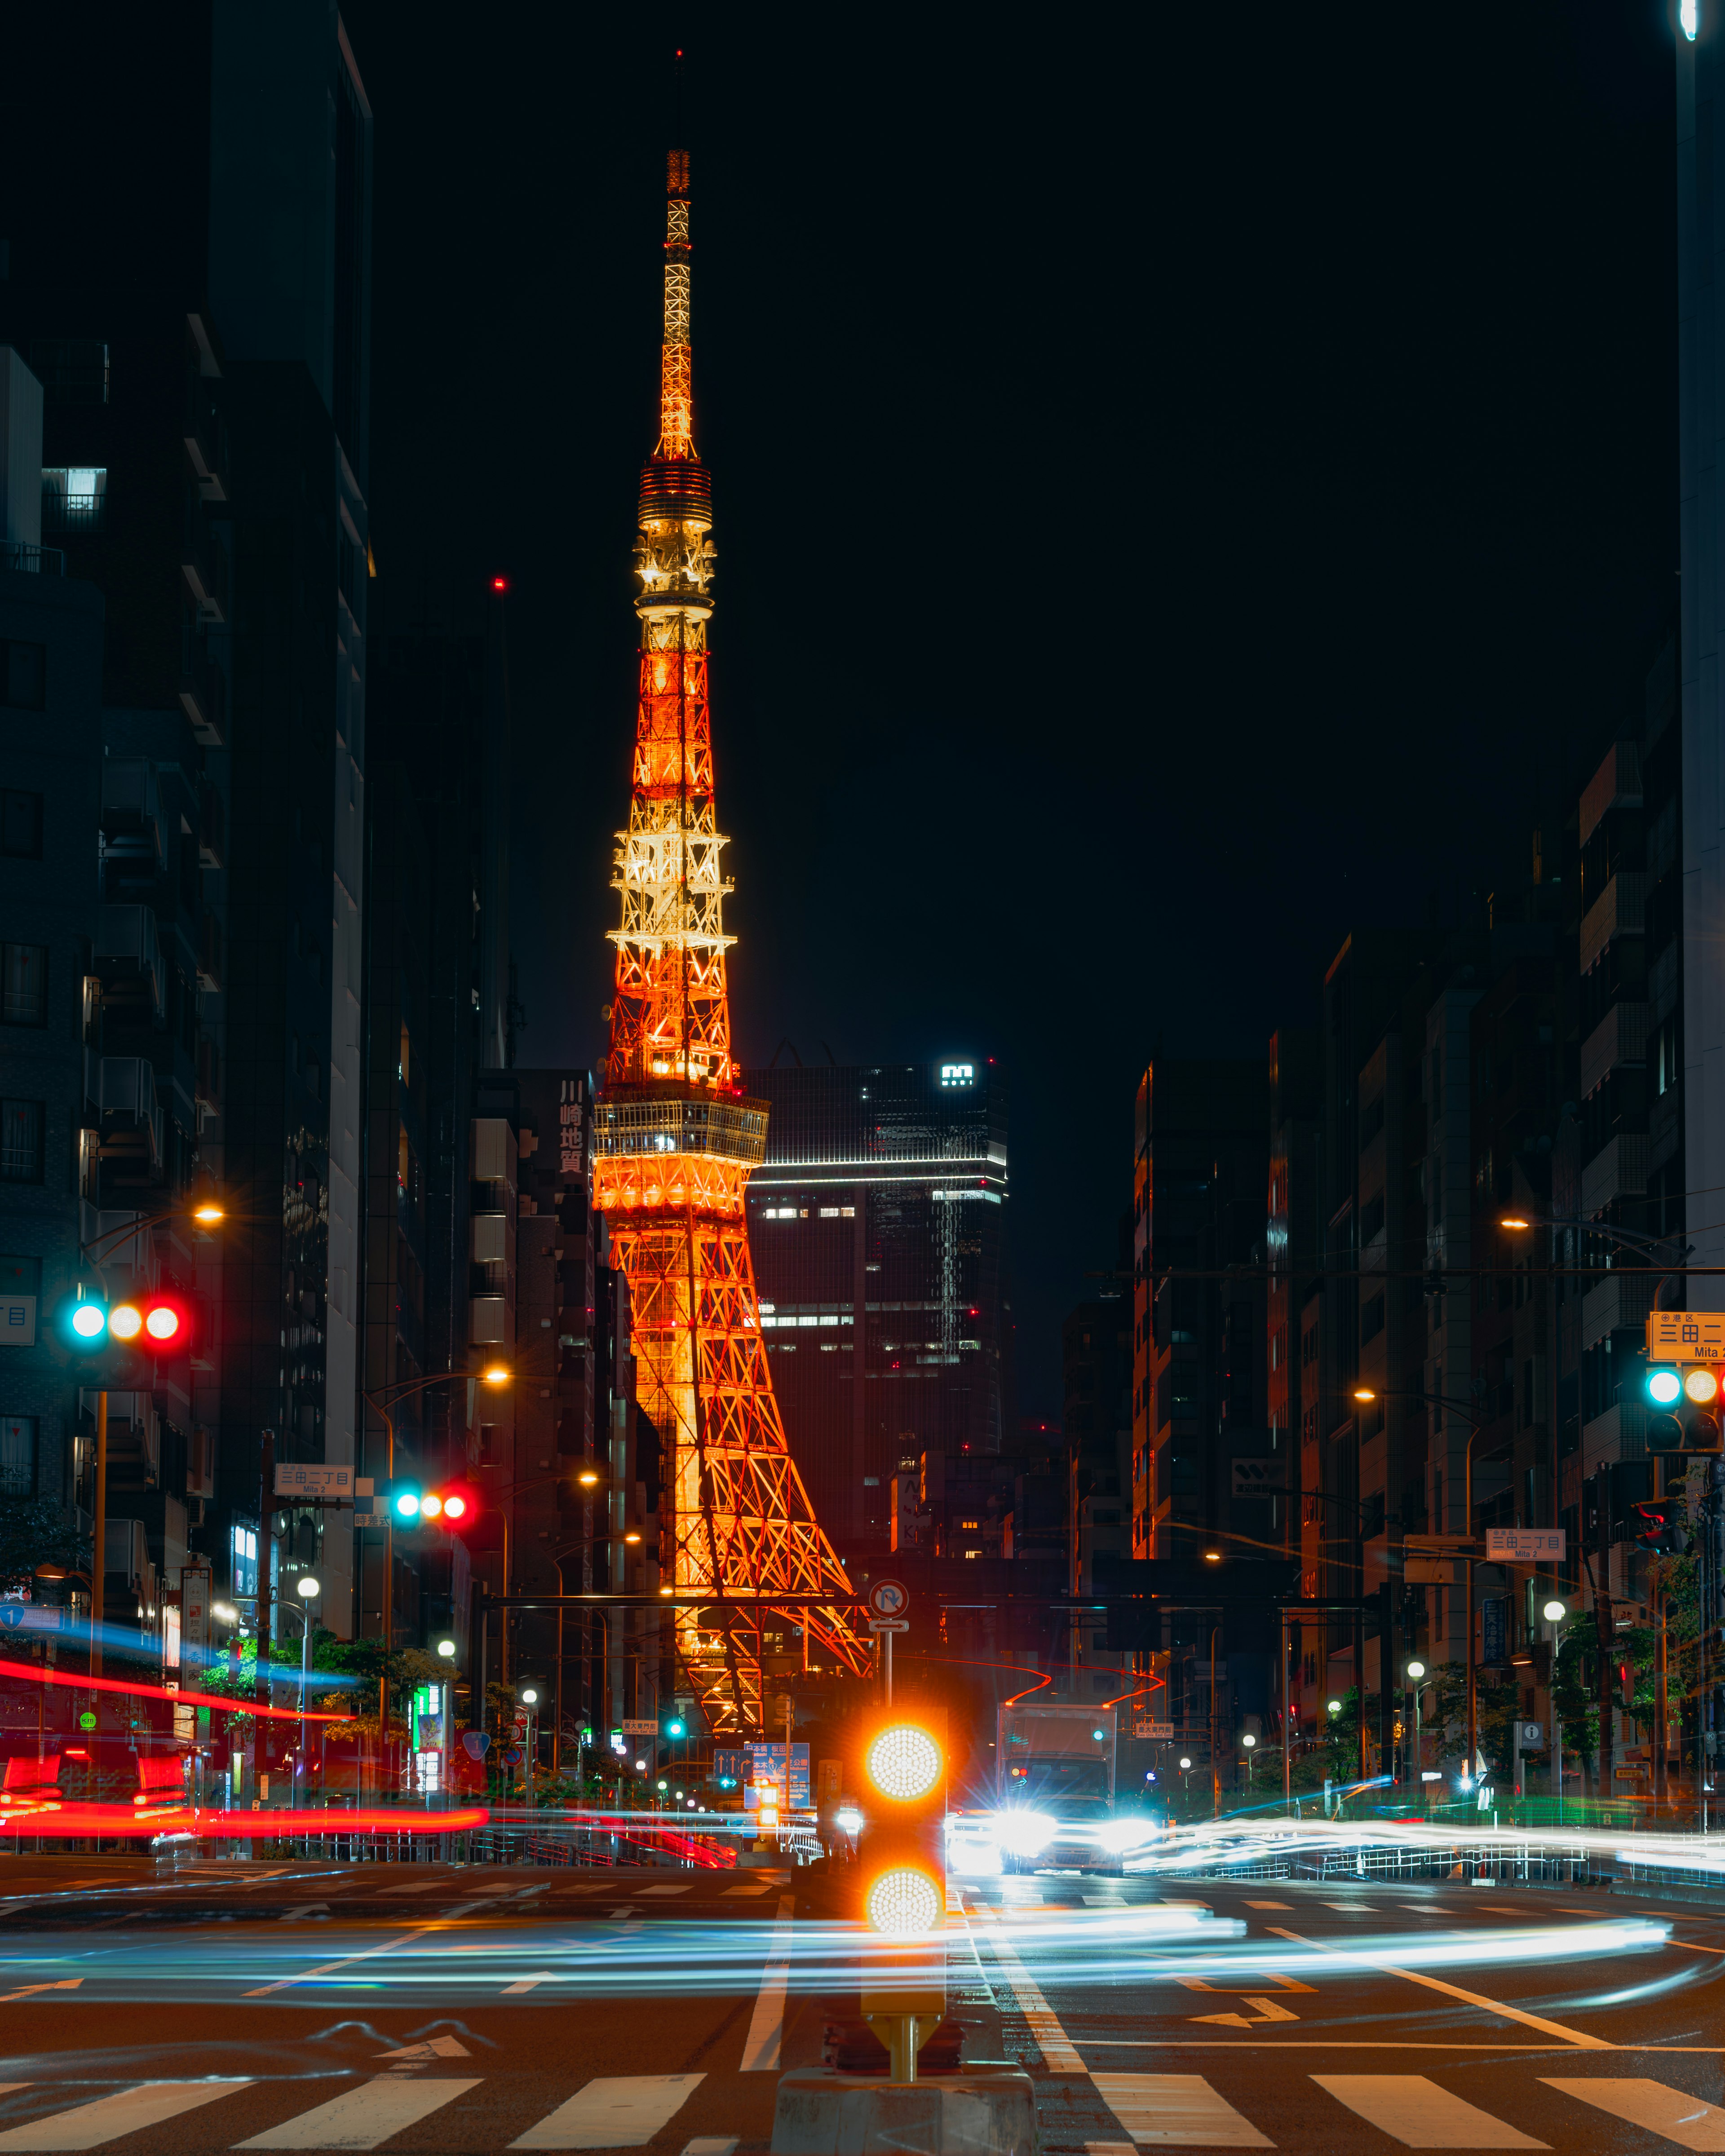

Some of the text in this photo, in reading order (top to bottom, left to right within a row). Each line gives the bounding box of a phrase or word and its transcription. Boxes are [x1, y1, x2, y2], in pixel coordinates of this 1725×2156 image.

[560, 1080, 583, 1173] 川崎地質
[1695, 1347, 1718, 1357] Mita
[281, 1472, 348, 1484] 三田二丁目
[356, 1515, 390, 1526] 時差式
[1493, 1537, 1559, 1548] 三田二丁目
[7, 1609, 14, 1624] 1
[26, 1610, 58, 1621] 桜田通り
[187, 1652, 202, 1681] 香家
[474, 1740, 479, 1750] 1
